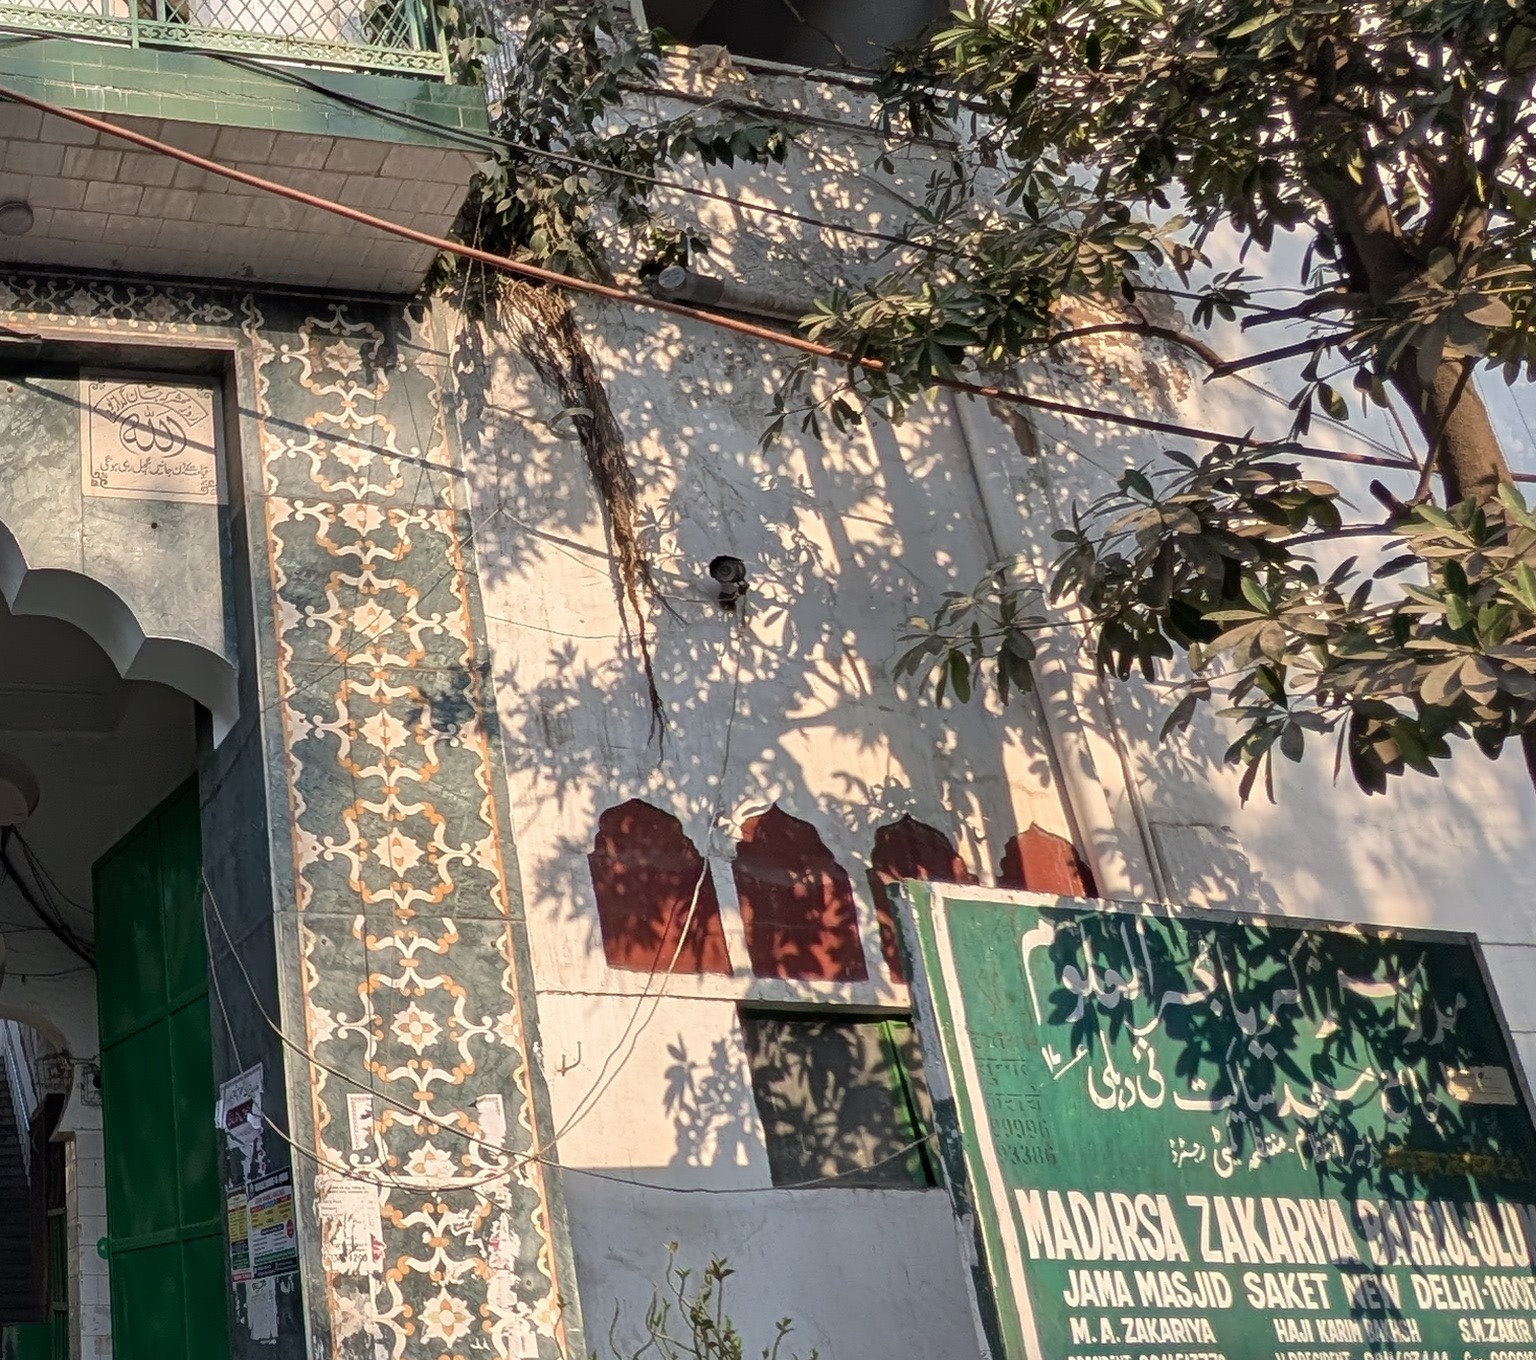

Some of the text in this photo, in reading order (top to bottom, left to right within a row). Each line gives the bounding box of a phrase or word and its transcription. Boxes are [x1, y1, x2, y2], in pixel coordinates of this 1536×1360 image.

[1014, 1189, 1191, 1262] MADARSA
[1186, 1195, 1360, 1264] ZAKARIYA
[1063, 1269, 1135, 1308] JAMA
[1134, 1271, 1233, 1309] MASJID
[1243, 1272, 1330, 1310] SAKET
[1340, 1273, 1402, 1310] NEW
[1120, 1318, 1218, 1344] ZAKARIYA
[1273, 1318, 1314, 1343] HAJI
[1315, 1319, 1363, 1343] KARIM
